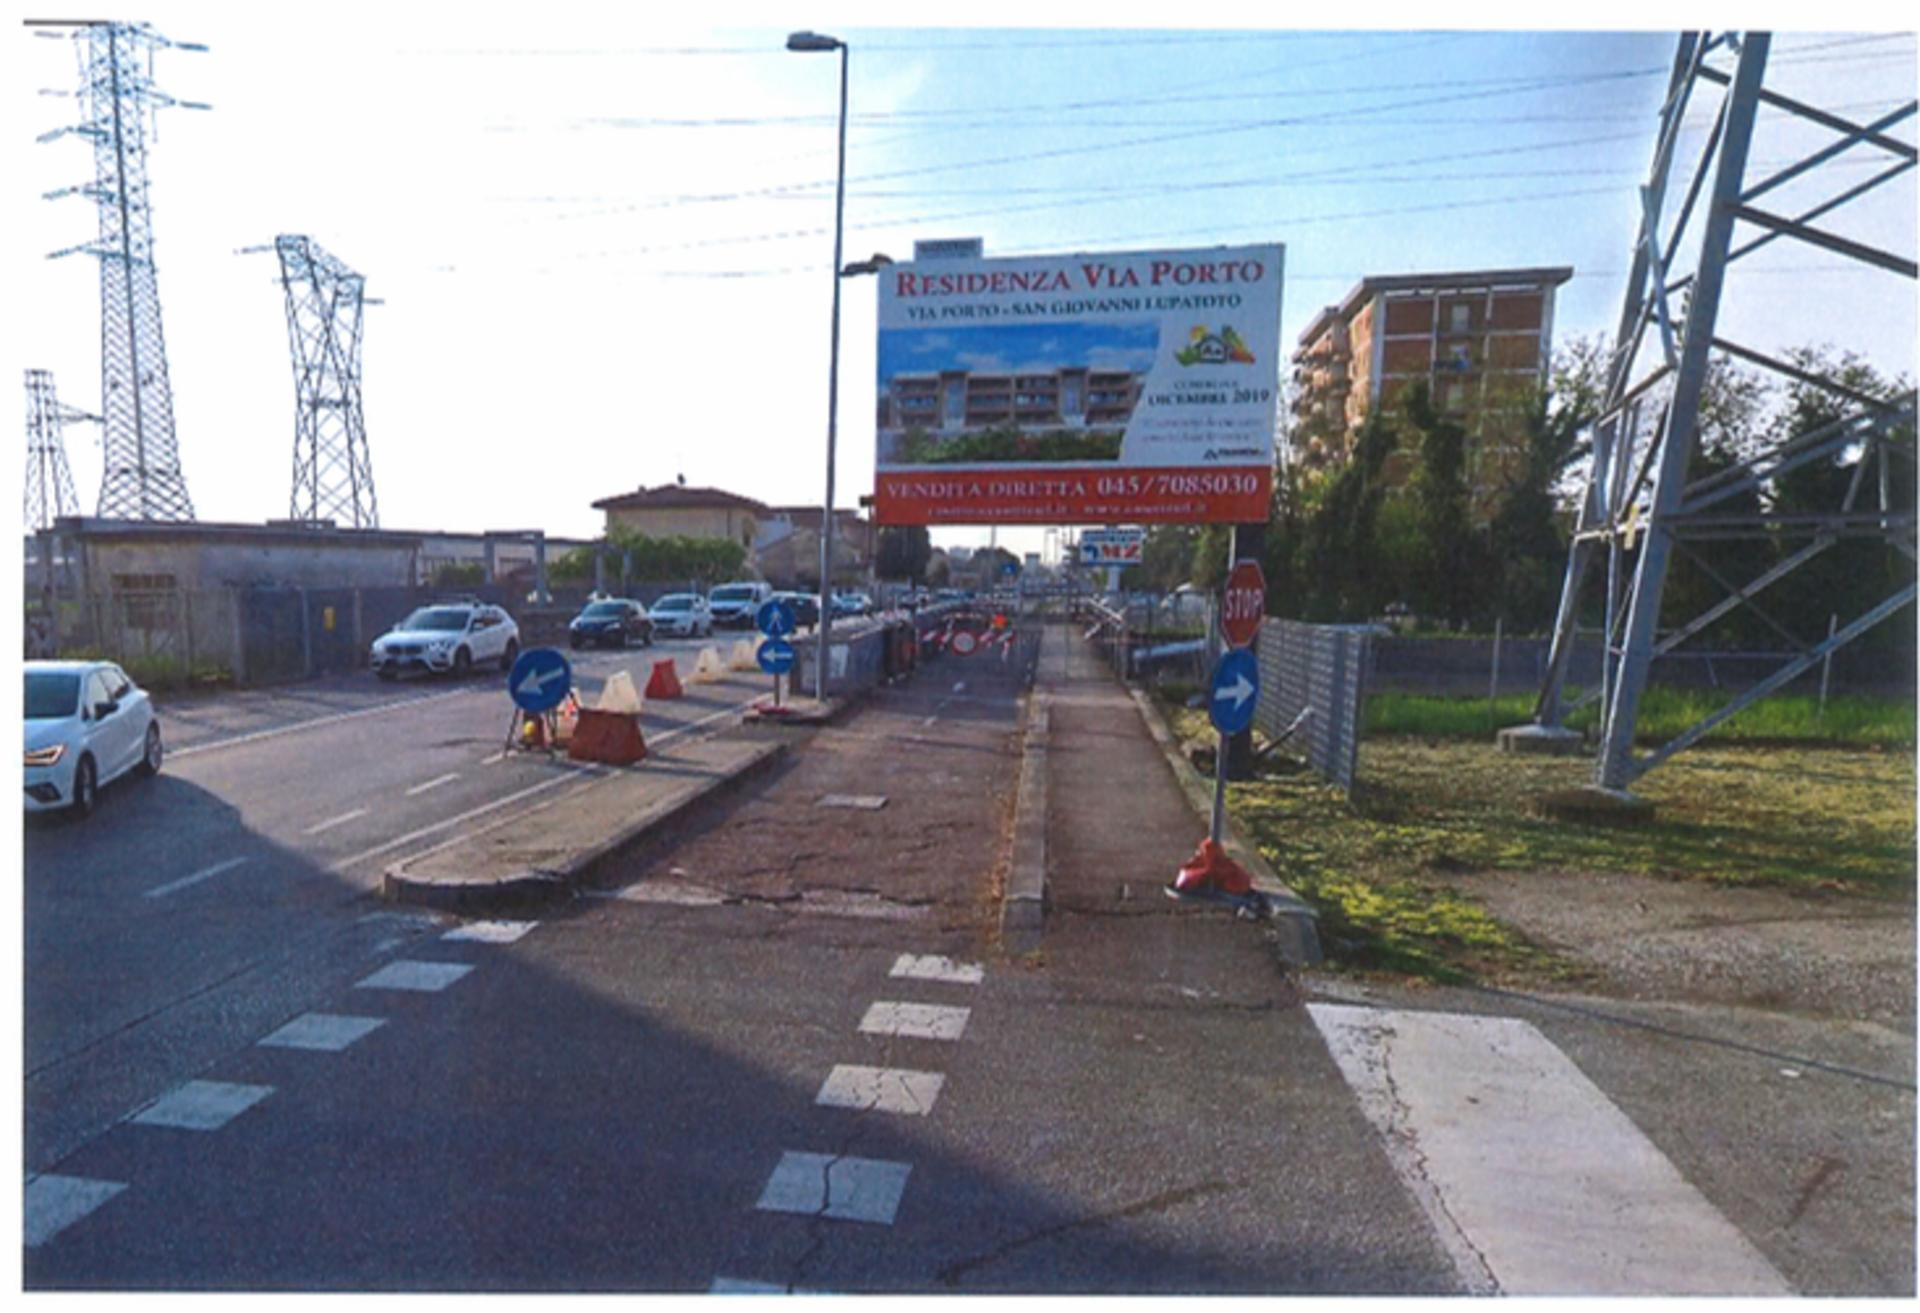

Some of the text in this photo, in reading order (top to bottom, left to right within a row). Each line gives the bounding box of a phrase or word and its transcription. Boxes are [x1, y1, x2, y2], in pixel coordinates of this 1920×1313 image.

[896, 259, 1264, 297] RESIDENZA VIA PORTO
[907, 305, 938, 321] VIA
[941, 303, 999, 319] PORTO
[1011, 301, 1046, 316] SAN
[1051, 297, 1140, 314] GIOVANNI
[1145, 294, 1241, 310] LUPATOTO
[1234, 389, 1270, 403] 2019
[886, 474, 1259, 498] VENDITA DIRETTA 045/7085030
[1226, 588, 1264, 619] STOP
